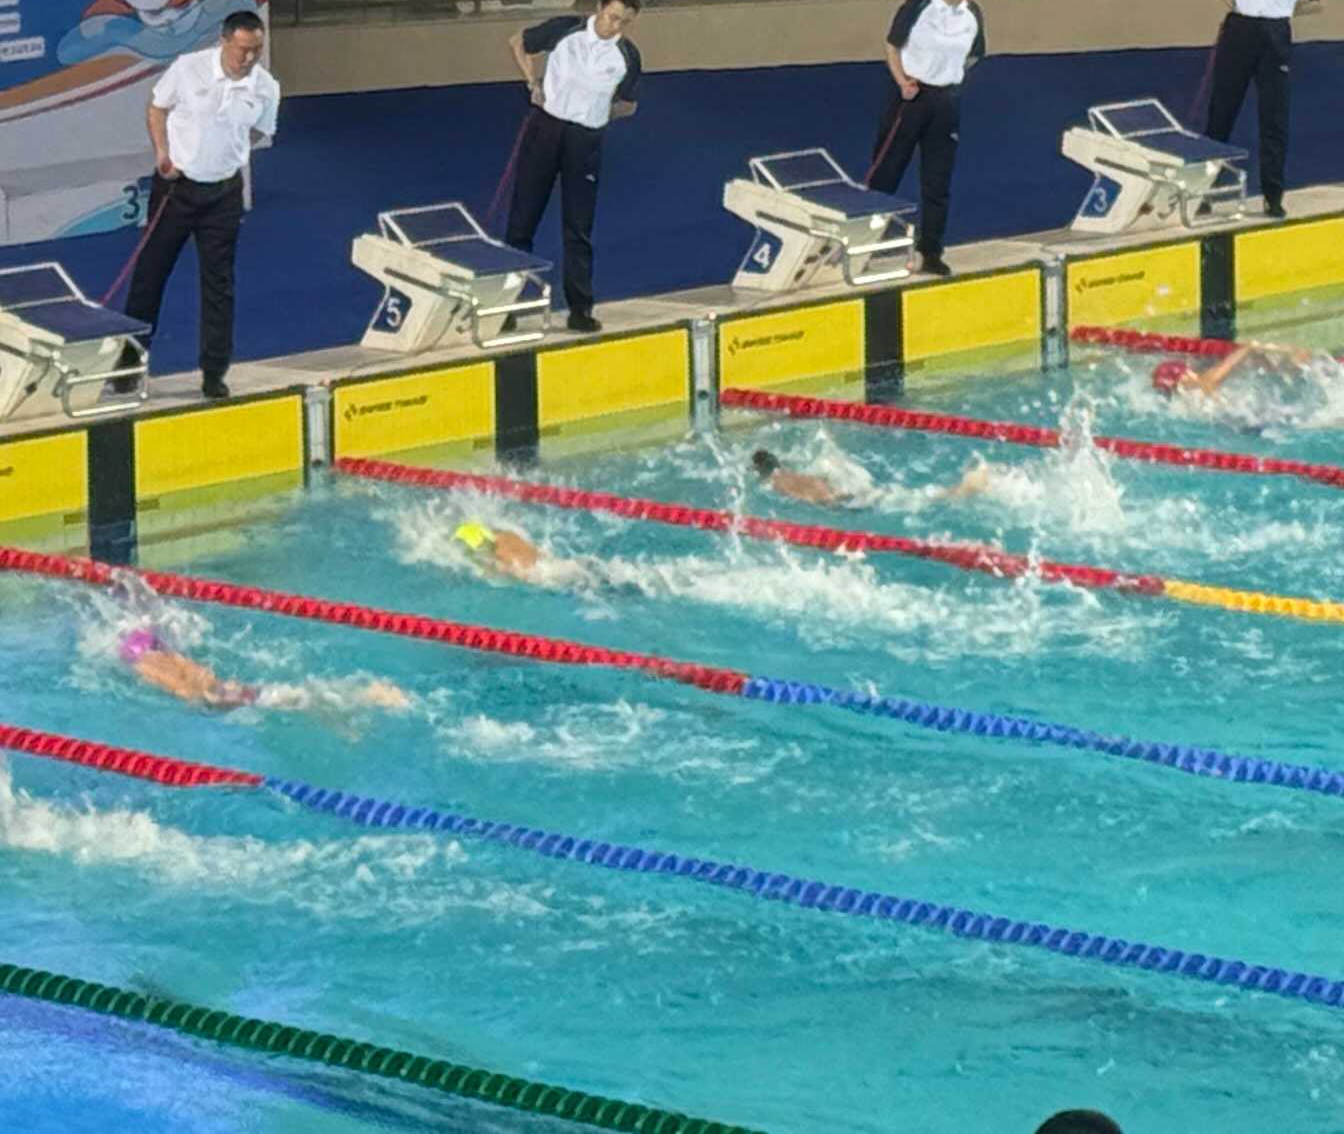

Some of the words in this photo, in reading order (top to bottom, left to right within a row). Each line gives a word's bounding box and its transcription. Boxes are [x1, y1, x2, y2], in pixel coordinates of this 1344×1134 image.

[122, 185, 141, 220] 3
[1093, 186, 1108, 213] 3
[753, 243, 771, 269] 4
[387, 297, 402, 327] 5
